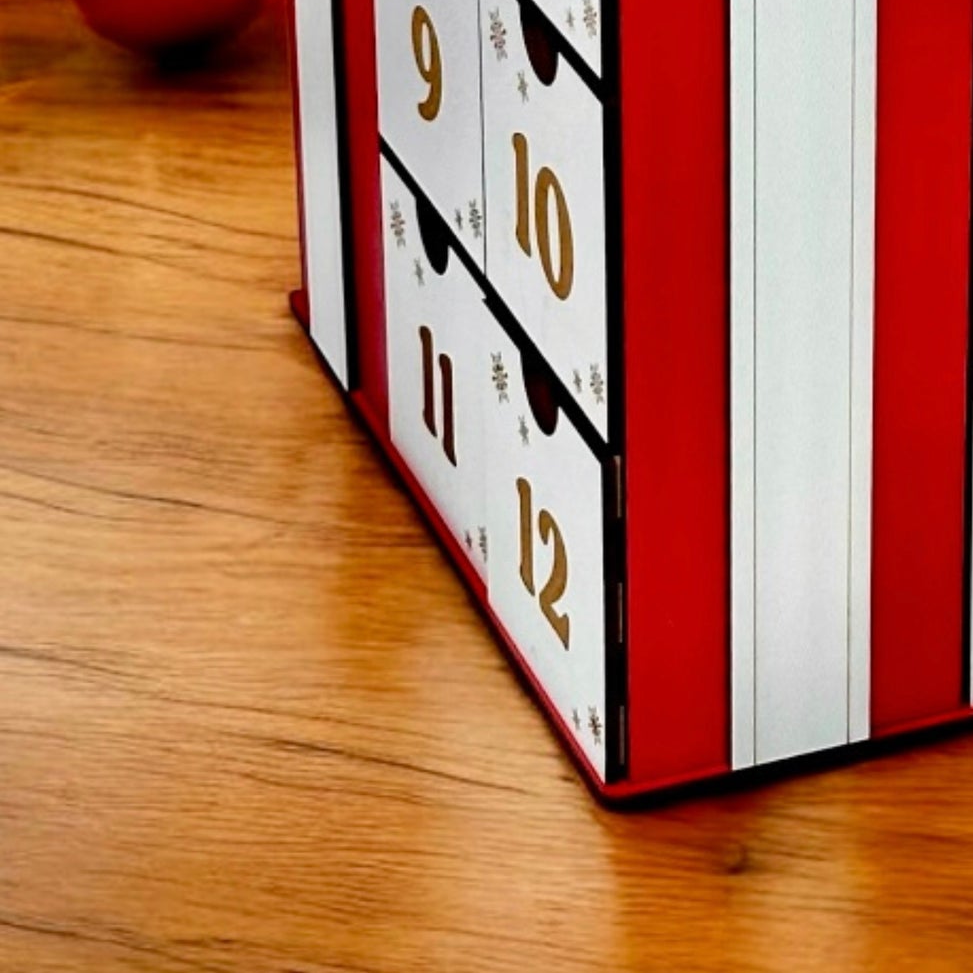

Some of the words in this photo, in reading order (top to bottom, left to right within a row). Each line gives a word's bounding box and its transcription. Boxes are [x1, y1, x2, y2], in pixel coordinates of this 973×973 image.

[412, 6, 443, 122] 9
[512, 133, 574, 301] 10
[419, 325, 458, 468] 11
[516, 477, 570, 651] 12
